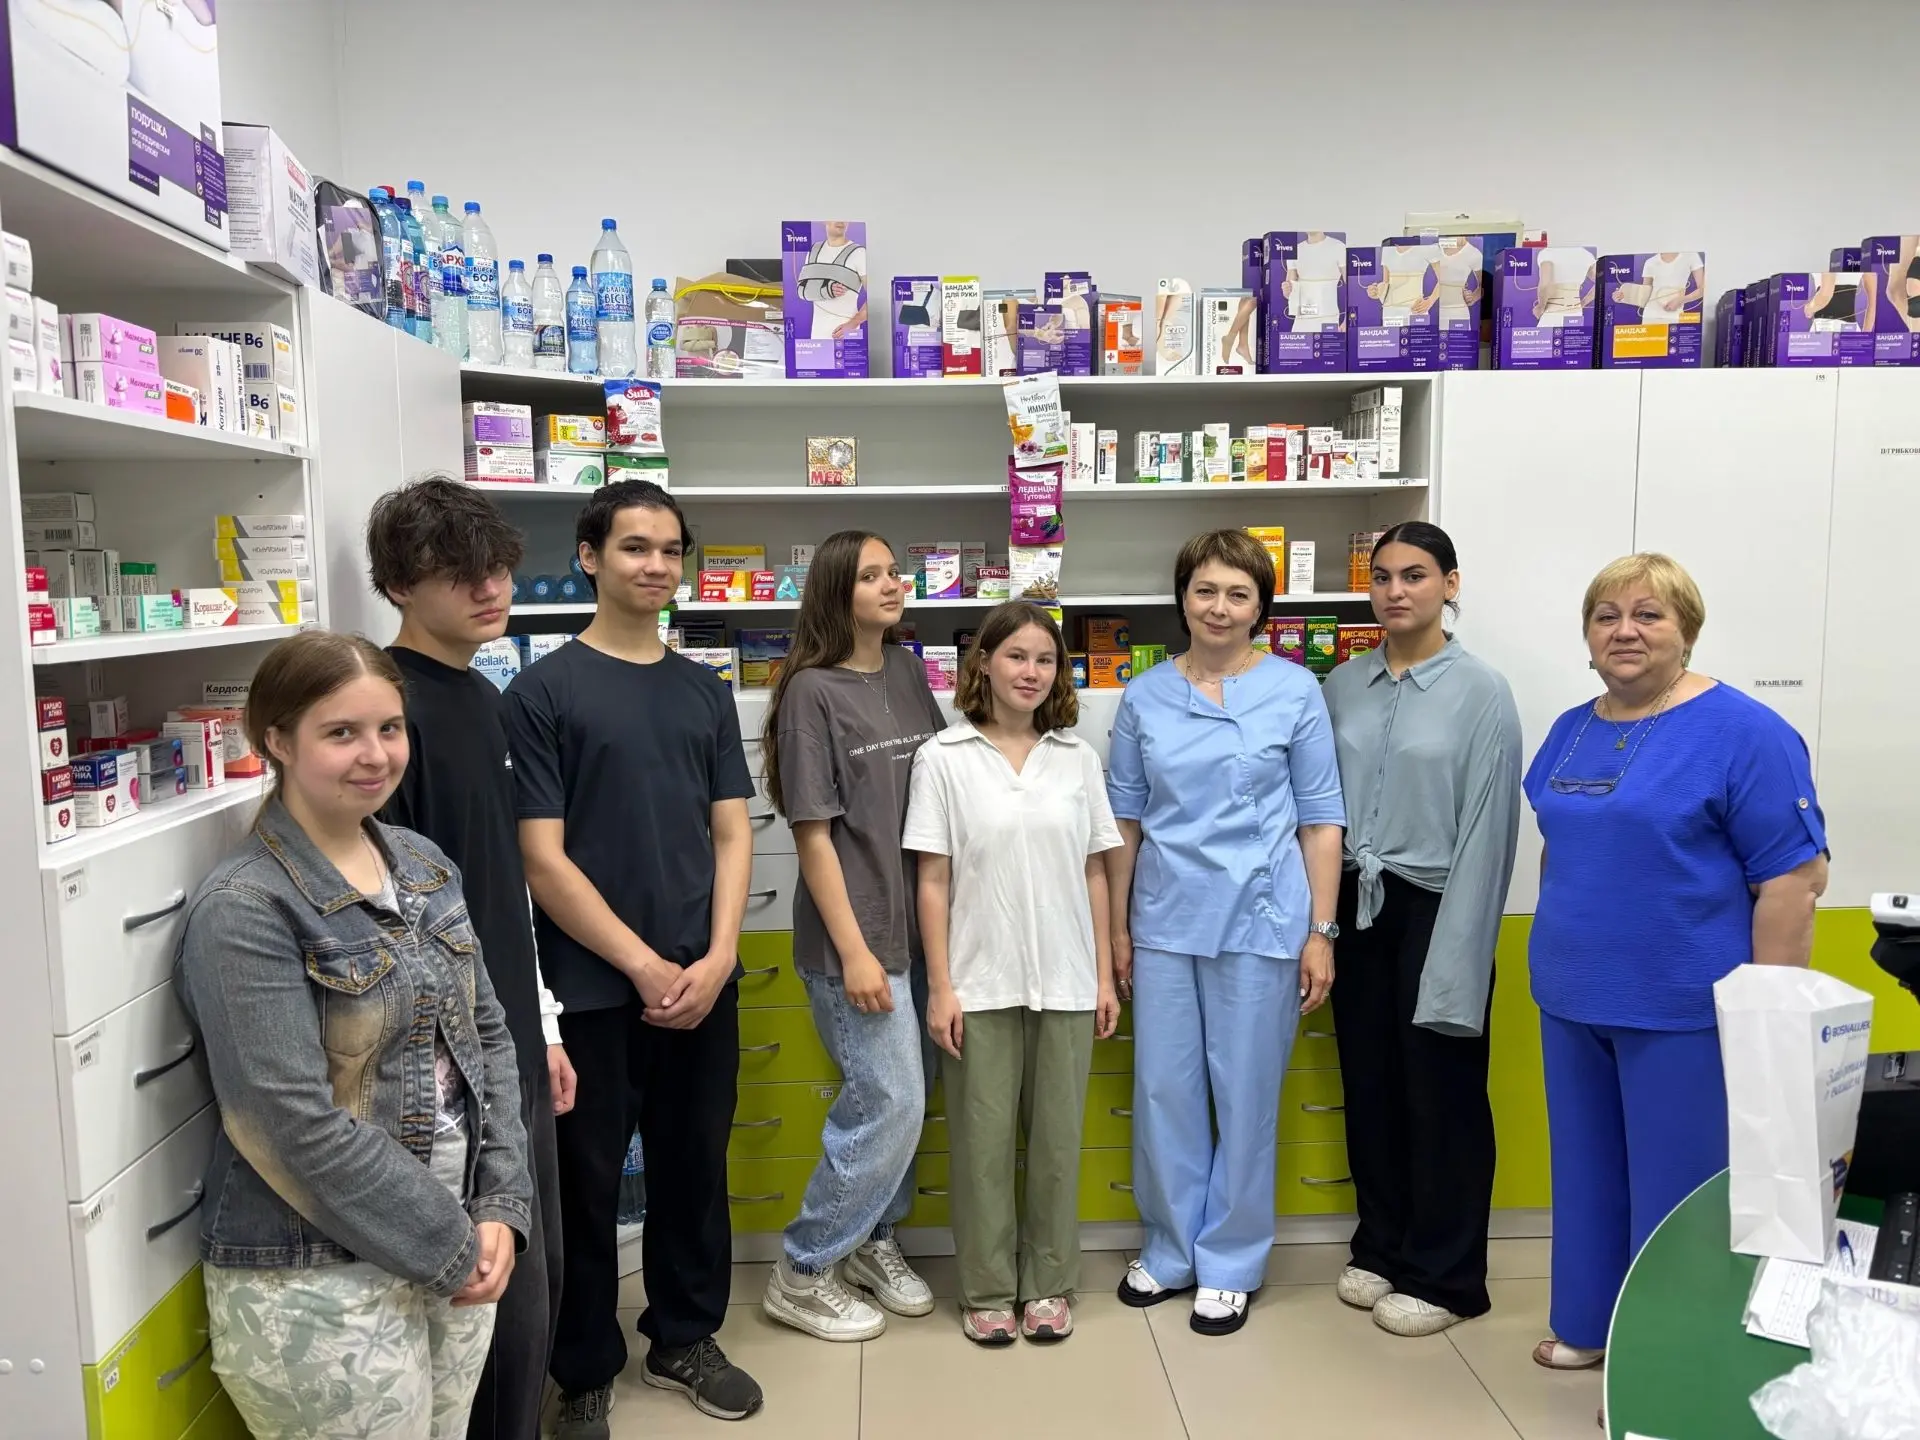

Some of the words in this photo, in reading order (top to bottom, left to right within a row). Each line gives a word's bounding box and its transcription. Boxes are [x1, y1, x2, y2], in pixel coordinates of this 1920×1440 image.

[131, 107, 168, 140] ПОДУШКА
[786, 233, 808, 243] Trives
[1276, 244, 1294, 252] Trives
[1876, 248, 1896, 257] Trives
[1352, 259, 1373, 268] Trives
[1510, 260, 1528, 268] Trives
[1846, 258, 1861, 267] Trive
[1609, 266, 1631, 275] Trives
[473, 273, 494, 283] БОР
[945, 284, 975, 292] БАНДАЖ
[1786, 284, 1805, 293] Trives
[945, 291, 960, 300] ДЛЯ
[960, 291, 979, 299] РУКИ
[1360, 329, 1390, 337] БАНДАЖ
[1615, 327, 1647, 335] БАНДАЖ
[245, 332, 264, 349] B6
[1027, 402, 1058, 414] ИММУНО
[587, 469, 595, 482] 4
[1018, 485, 1056, 494] ЛЕДЕНЦЫ
[1023, 493, 1052, 502] Тутовые
[708, 557, 746, 566] РЕГИДРОН
[705, 574, 729, 583] Ренни
[756, 574, 775, 582] Ренн
[194, 601, 222, 614] Кораксан
[1307, 622, 1336, 632] МАКСИКОЛД
[1341, 629, 1380, 641] МАКСИКОЛД
[474, 654, 509, 668] Bellakt
[501, 666, 518, 678] 0-6
[206, 684, 249, 695] Кардоса
[43, 701, 62, 711] КАРДИО
[848, 747, 866, 758] ONE
[866, 742, 880, 753] DAY
[52, 771, 71, 784] КАРДИО
[68, 883, 78, 897] 99
[78, 1051, 92, 1068] 100
[90, 1203, 102, 1221] 101
